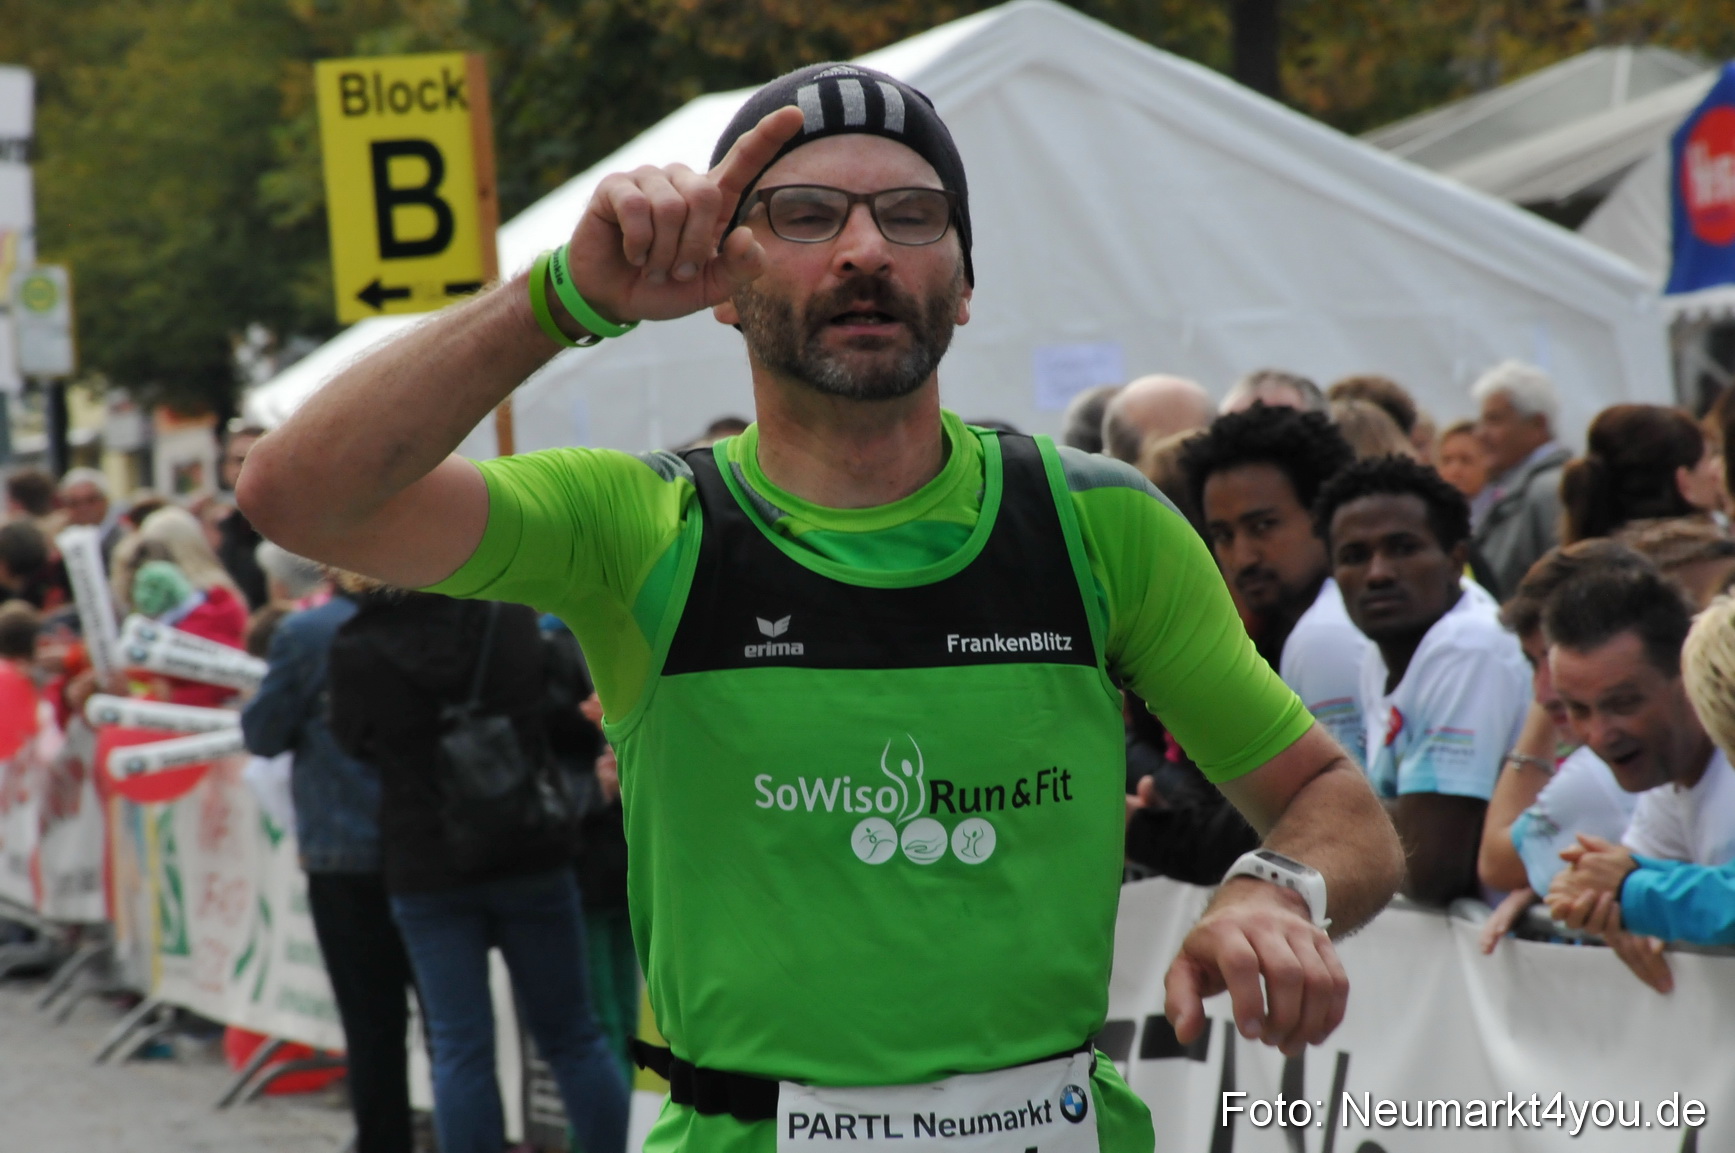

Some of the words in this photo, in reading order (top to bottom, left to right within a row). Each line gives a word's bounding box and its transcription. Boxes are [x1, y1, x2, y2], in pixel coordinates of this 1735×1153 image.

[339, 66, 469, 117] Block
[369, 137, 456, 260] B
[744, 641, 804, 658] erima
[946, 631, 1073, 653] FrankenBlitz
[754, 774, 899, 814] SoWiso
[788, 1112, 903, 1139] PARTL
[913, 1099, 1053, 1137] Neumarkt
